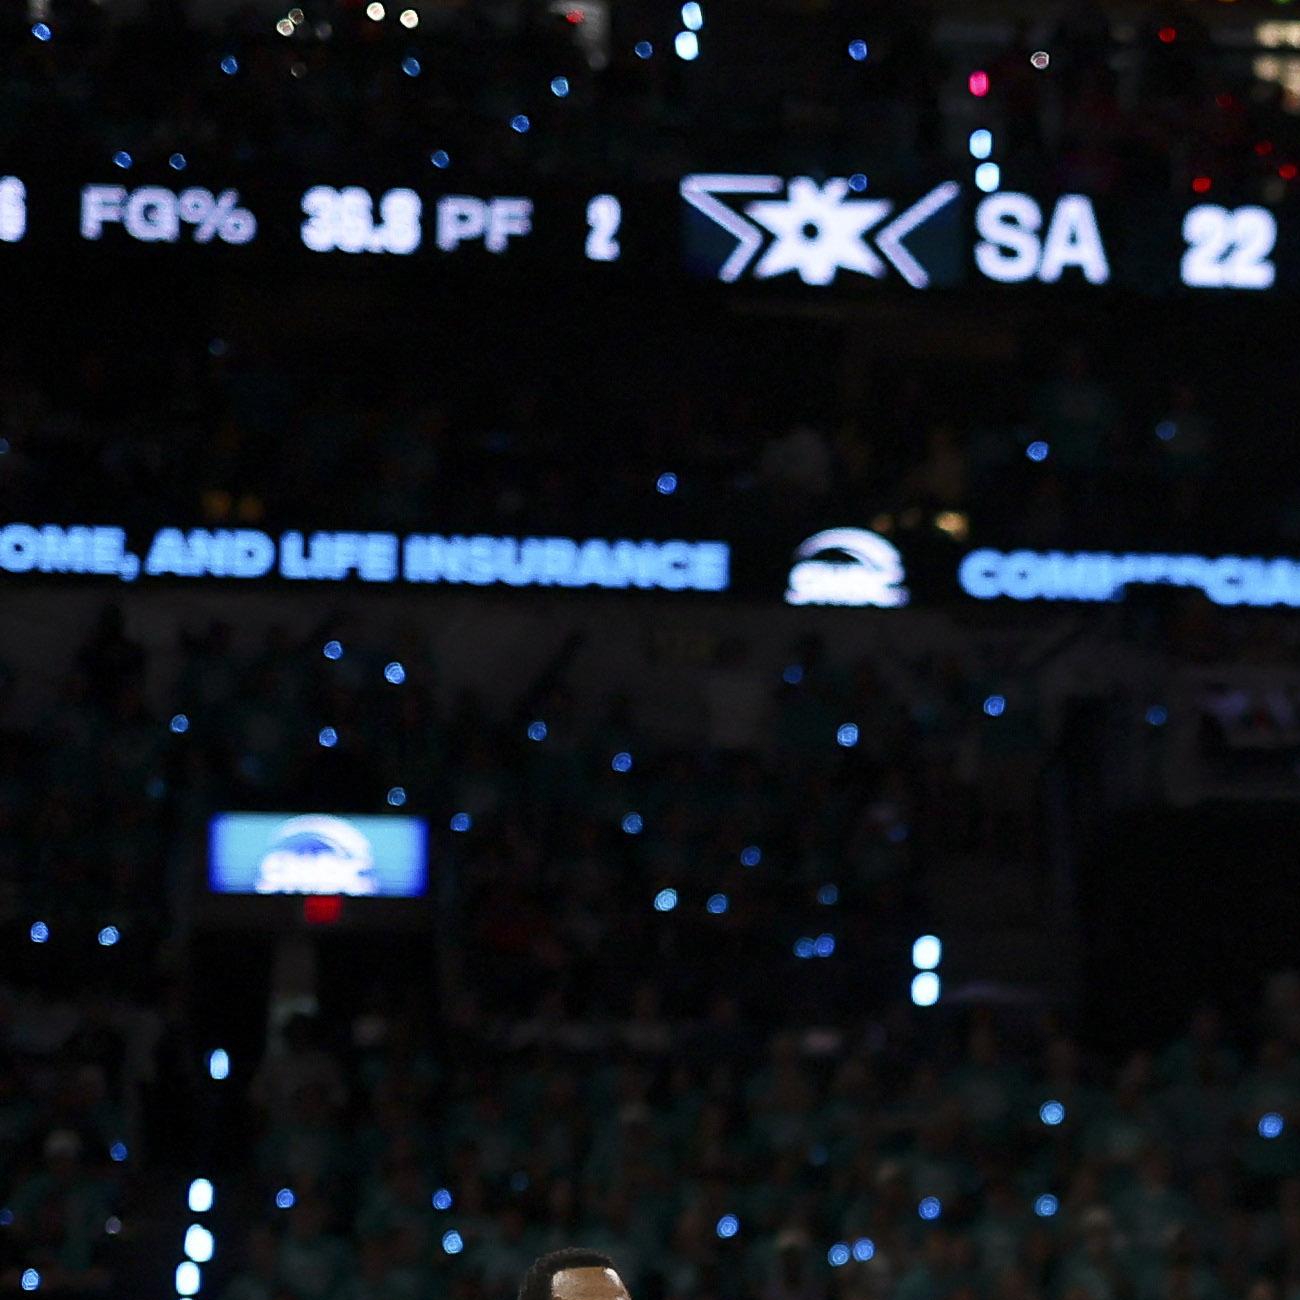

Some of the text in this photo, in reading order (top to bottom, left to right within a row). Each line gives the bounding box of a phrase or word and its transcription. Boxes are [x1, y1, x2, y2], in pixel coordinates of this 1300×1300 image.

[81, 185, 256, 244] FG%
[436, 196, 533, 252] PF
[585, 194, 621, 261] 2
[974, 192, 1110, 284] SA
[1181, 204, 1277, 290] 22
[145, 529, 276, 577] AND
[280, 532, 399, 582] LIFE
[403, 535, 730, 592] INSURANCE
